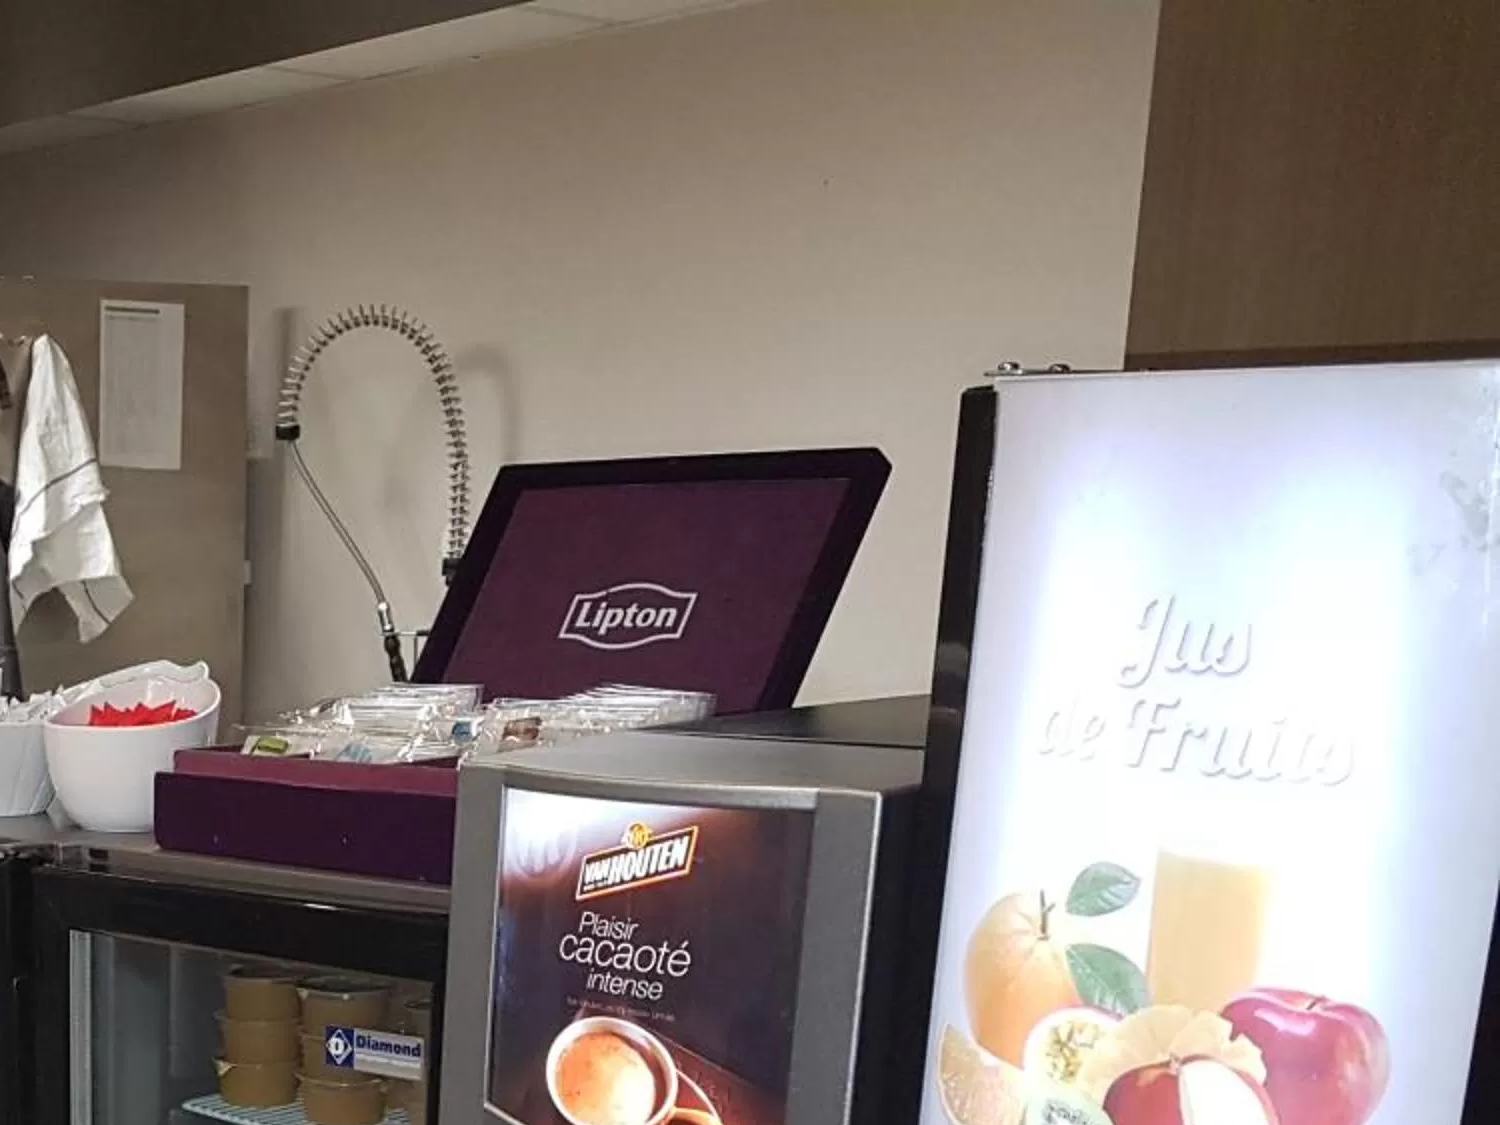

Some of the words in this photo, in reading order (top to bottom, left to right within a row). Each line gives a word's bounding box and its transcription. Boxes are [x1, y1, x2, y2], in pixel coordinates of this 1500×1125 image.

[575, 601, 678, 635] Lipton
[1116, 594, 1253, 688] Jus
[1127, 697, 1354, 786] Fruits
[608, 836, 690, 886] HOUTEN
[579, 911, 638, 940] Plaisir
[559, 934, 691, 977] cacaoté
[587, 968, 663, 1000] intense
[356, 1035, 421, 1057] Diamond
